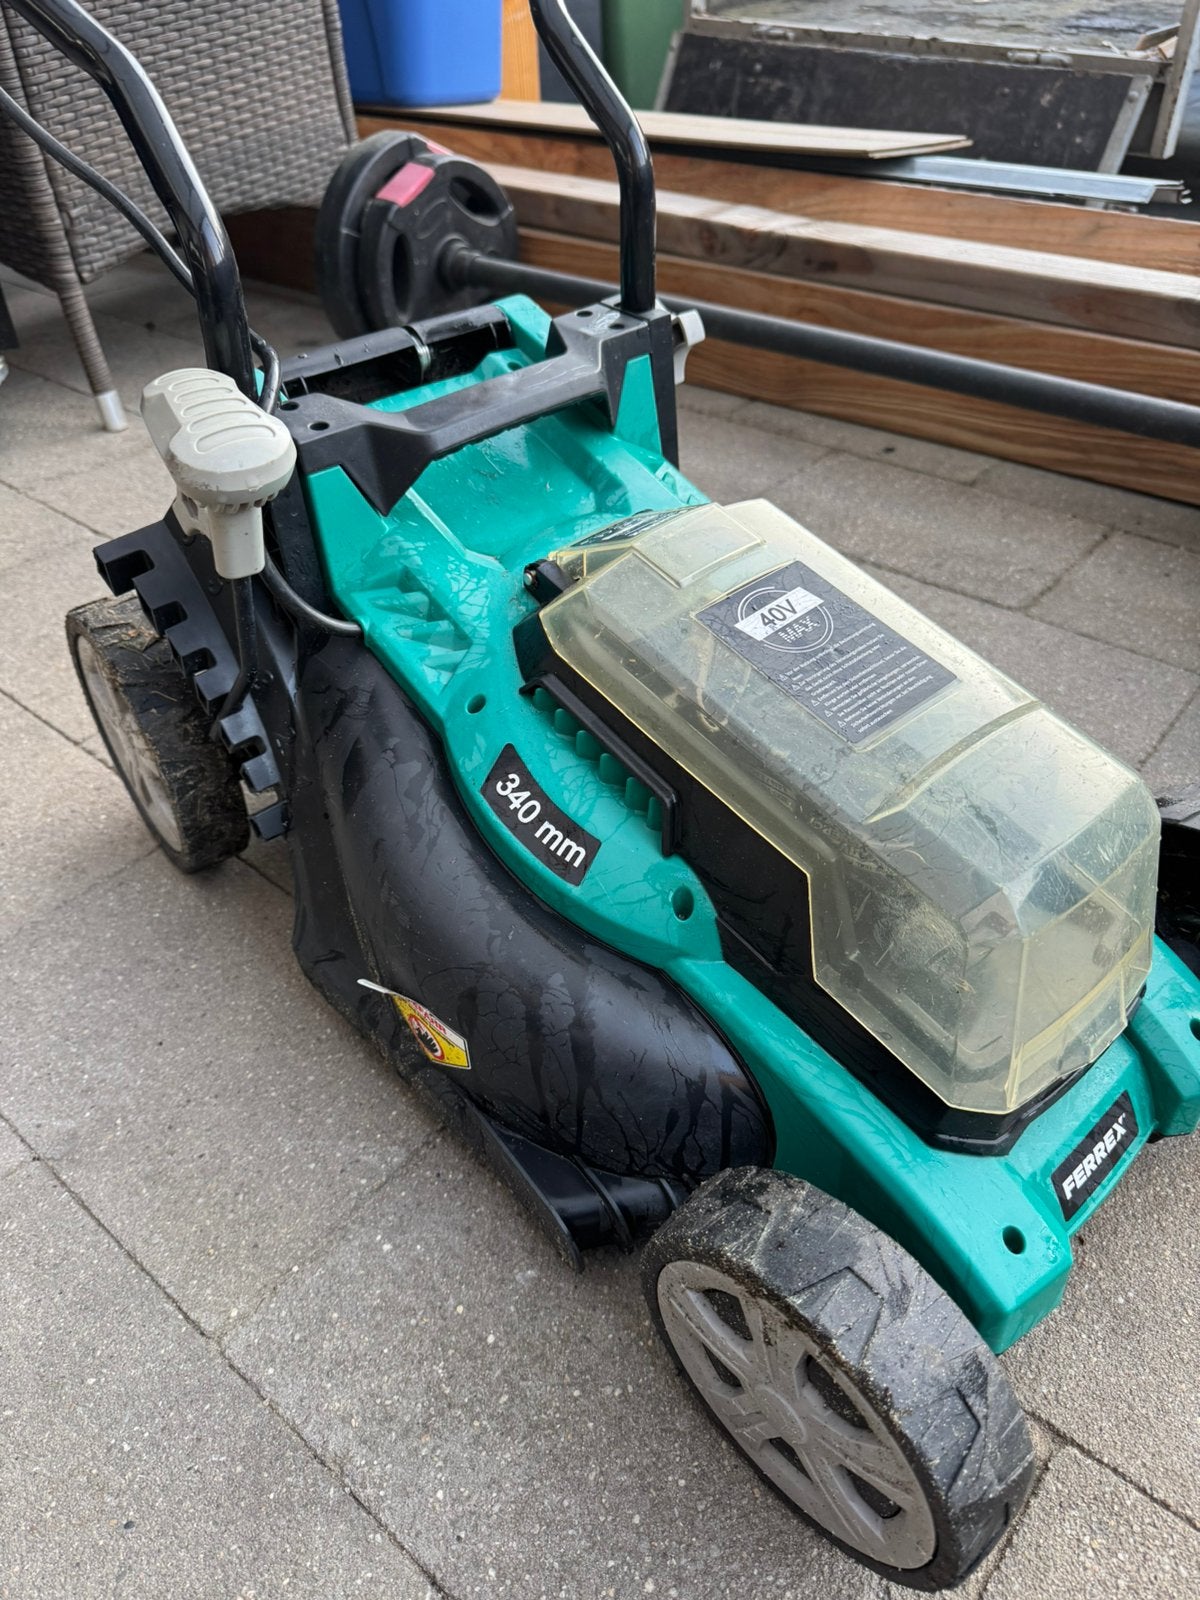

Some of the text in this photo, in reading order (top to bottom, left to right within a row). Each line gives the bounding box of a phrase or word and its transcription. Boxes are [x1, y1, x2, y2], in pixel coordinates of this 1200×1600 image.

[761, 599, 798, 629] 40V
[777, 615, 821, 644] MAX
[495, 773, 586, 868] 340 mm
[1062, 1112, 1127, 1201] FERREX
